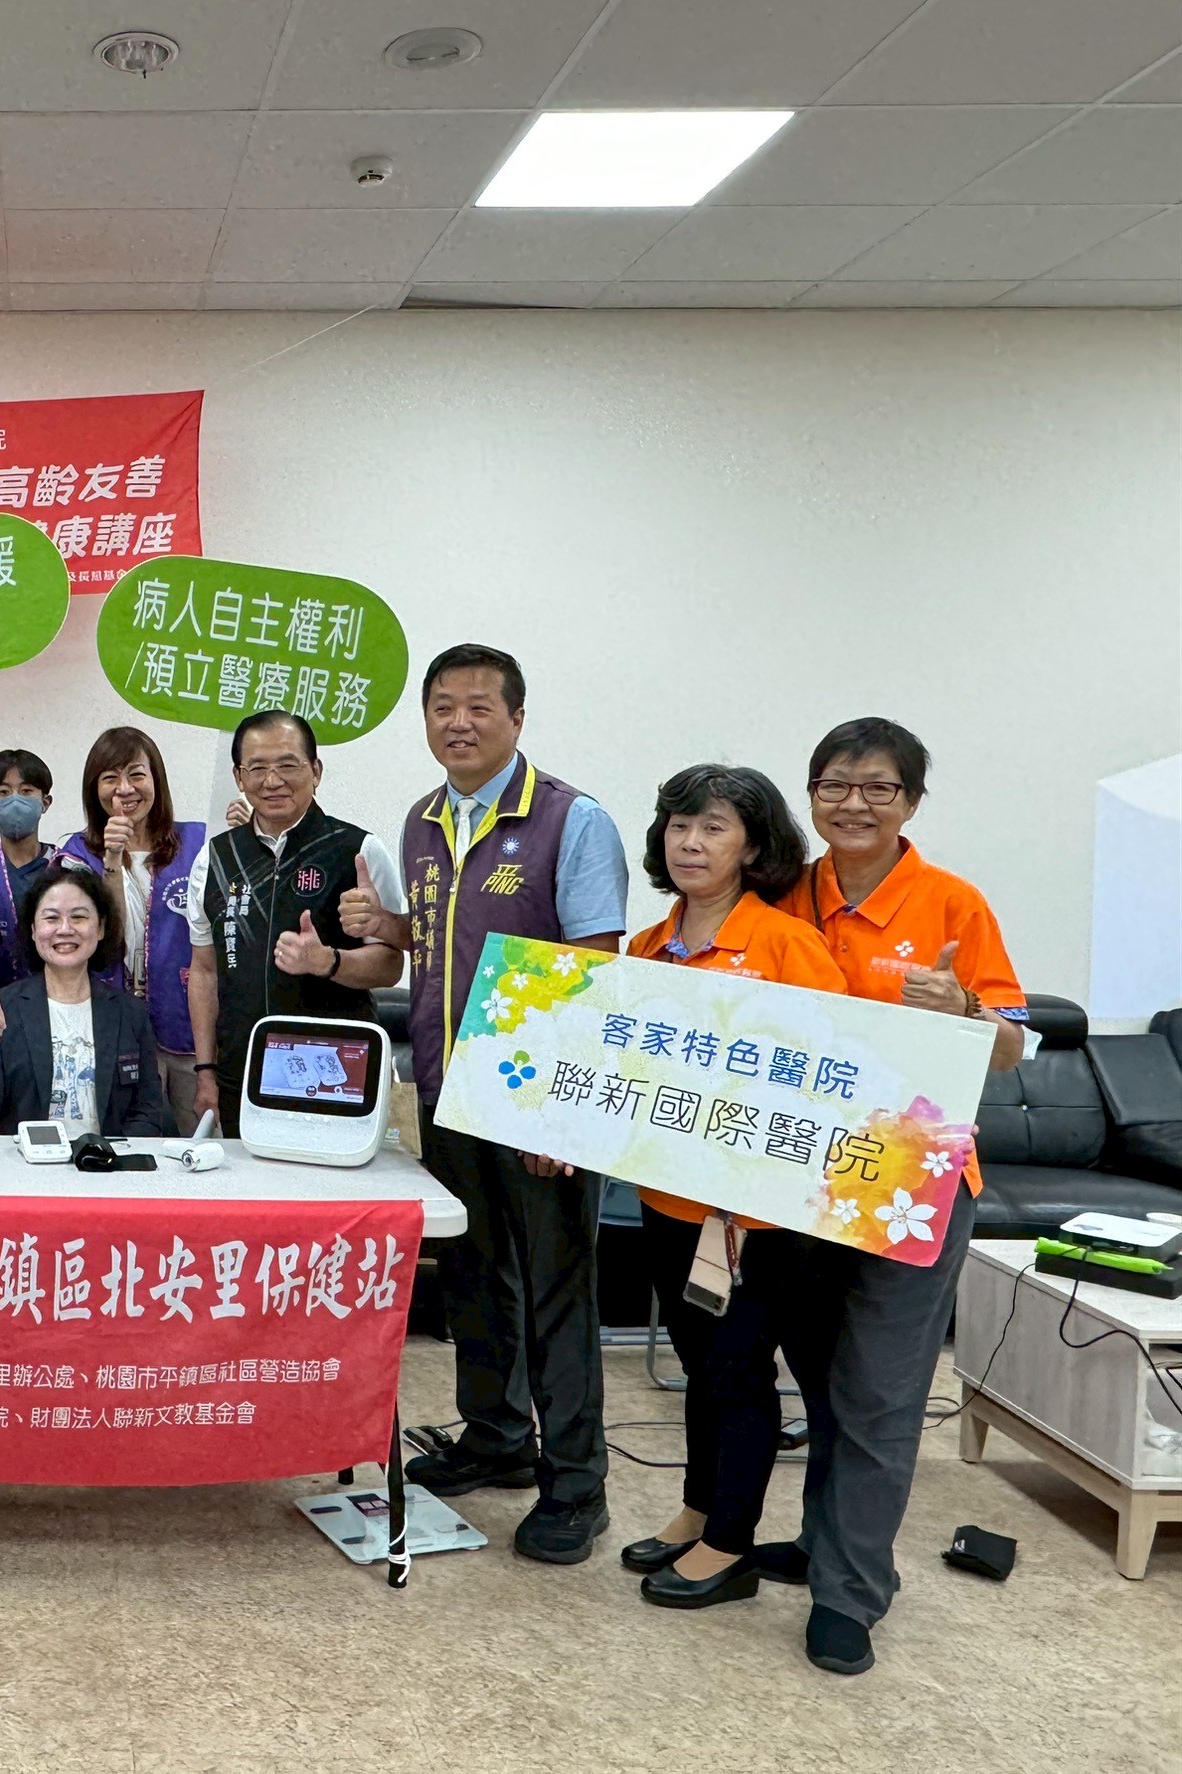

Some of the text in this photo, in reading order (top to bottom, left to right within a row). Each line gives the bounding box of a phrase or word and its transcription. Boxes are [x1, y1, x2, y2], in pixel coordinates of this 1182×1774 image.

[35, 512, 177, 559] 康講座
[132, 577, 364, 661] 病人自主權利
[125, 641, 372, 729] /預立醫療服務
[480, 875, 524, 895] PING
[600, 1011, 861, 1100] 客家特色醫院
[546, 1059, 886, 1182] 聯新國際醫院
